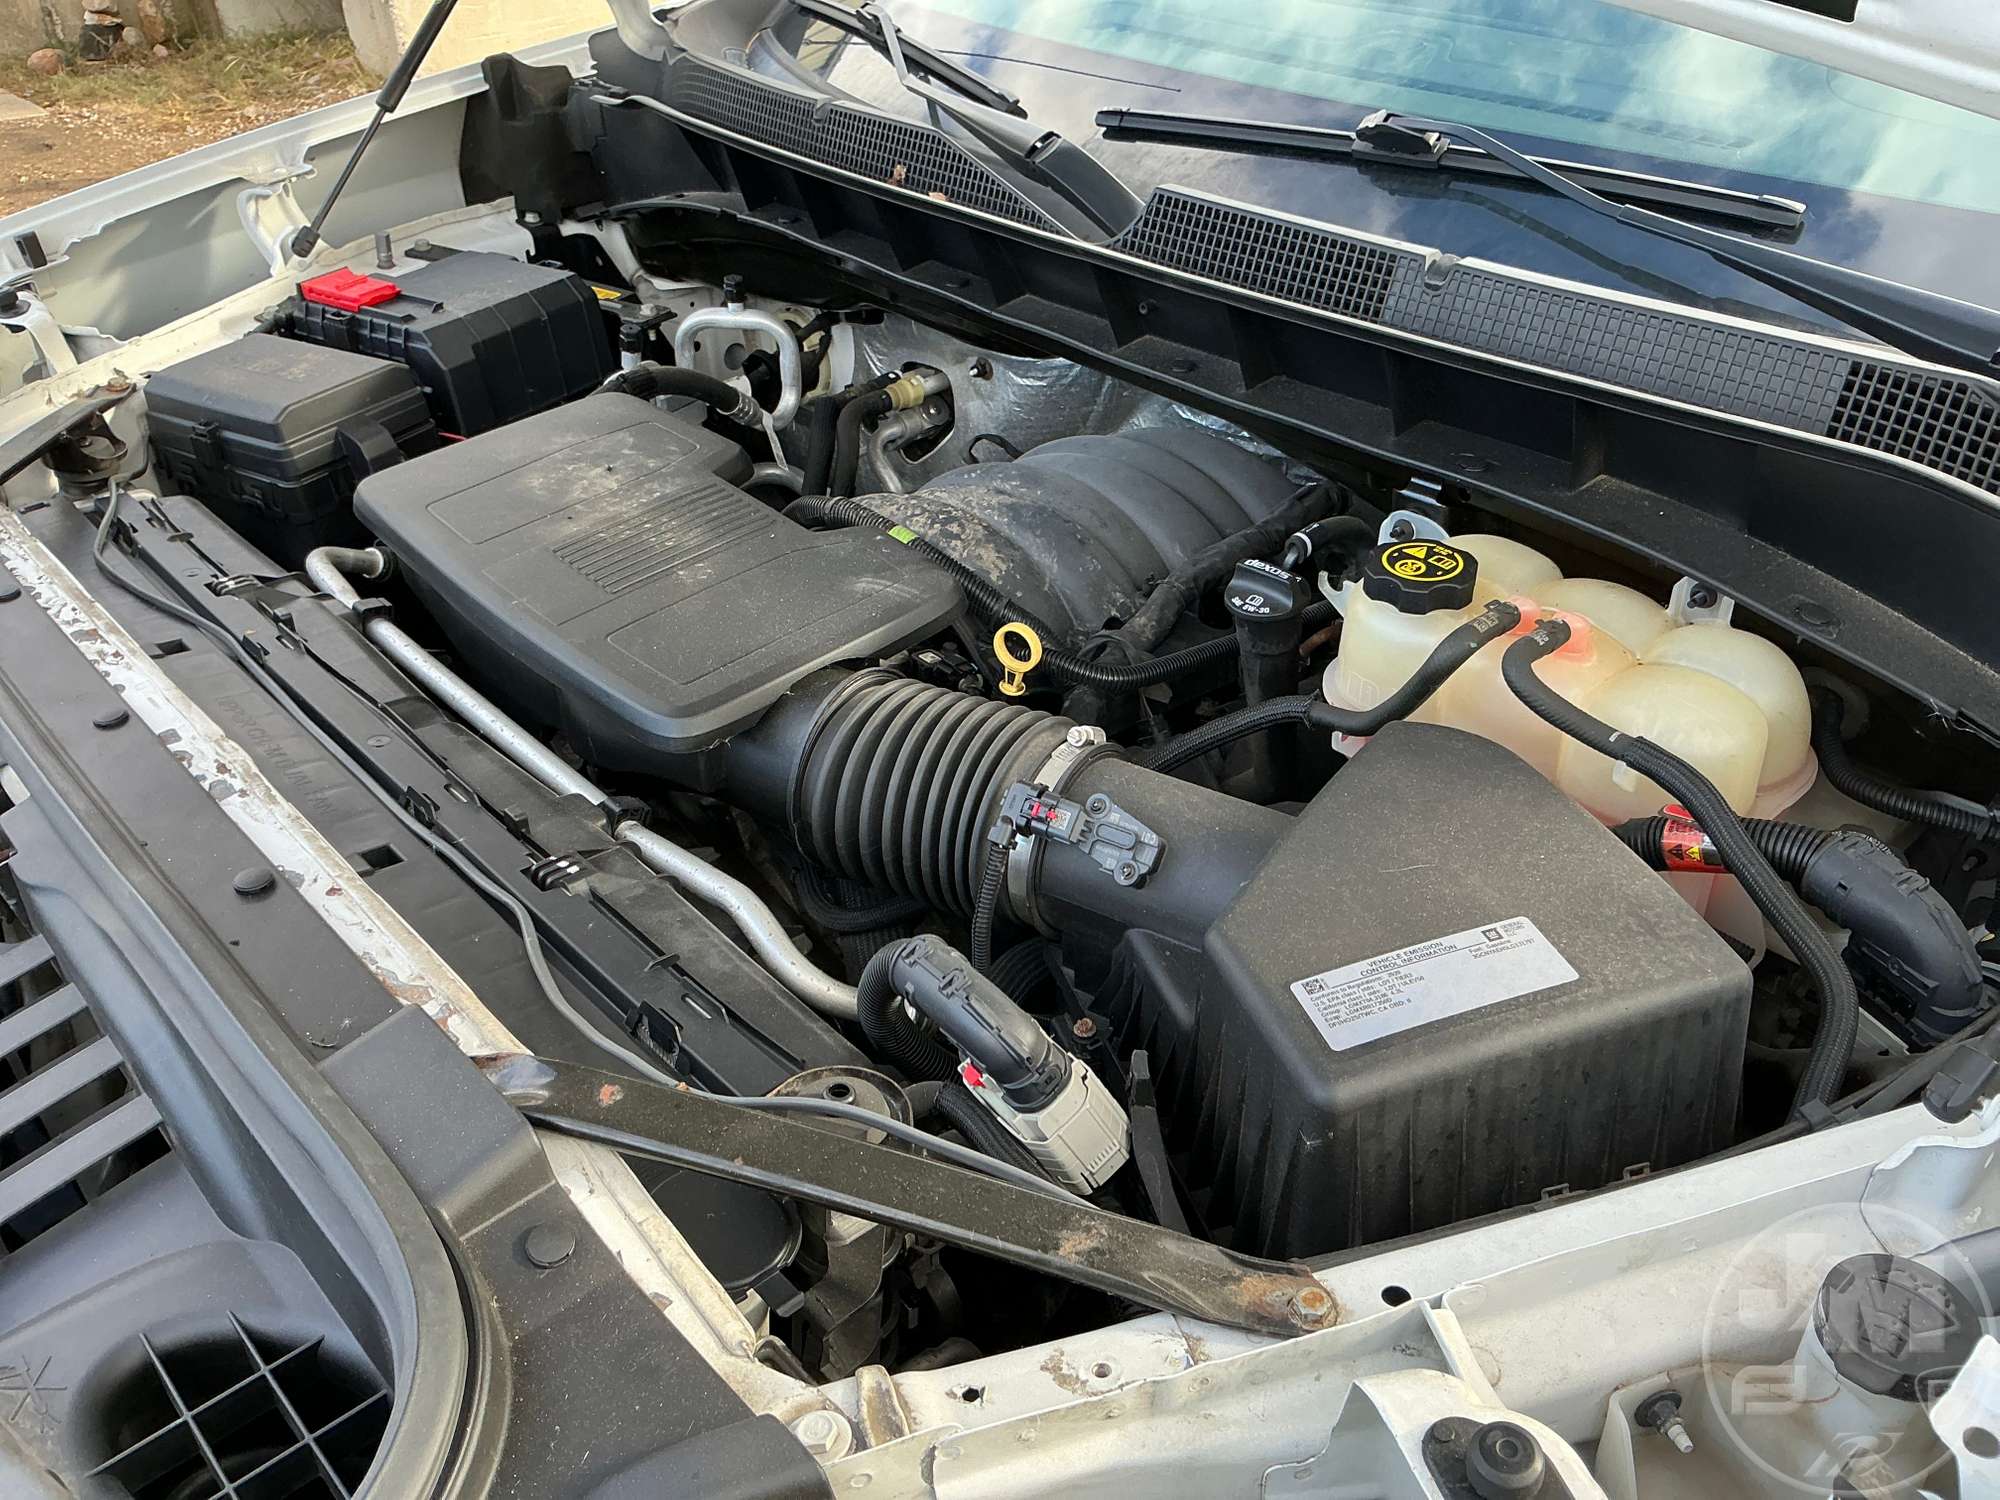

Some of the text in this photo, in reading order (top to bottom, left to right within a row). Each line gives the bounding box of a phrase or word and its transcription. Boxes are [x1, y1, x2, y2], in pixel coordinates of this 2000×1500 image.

[1244, 559, 1293, 580] dexos
[1242, 604, 1270, 614] 5W-30
[1361, 945, 1458, 977] CONTROL INFORMATION
[1368, 942, 1444, 968] VEHICLE EMISSION
